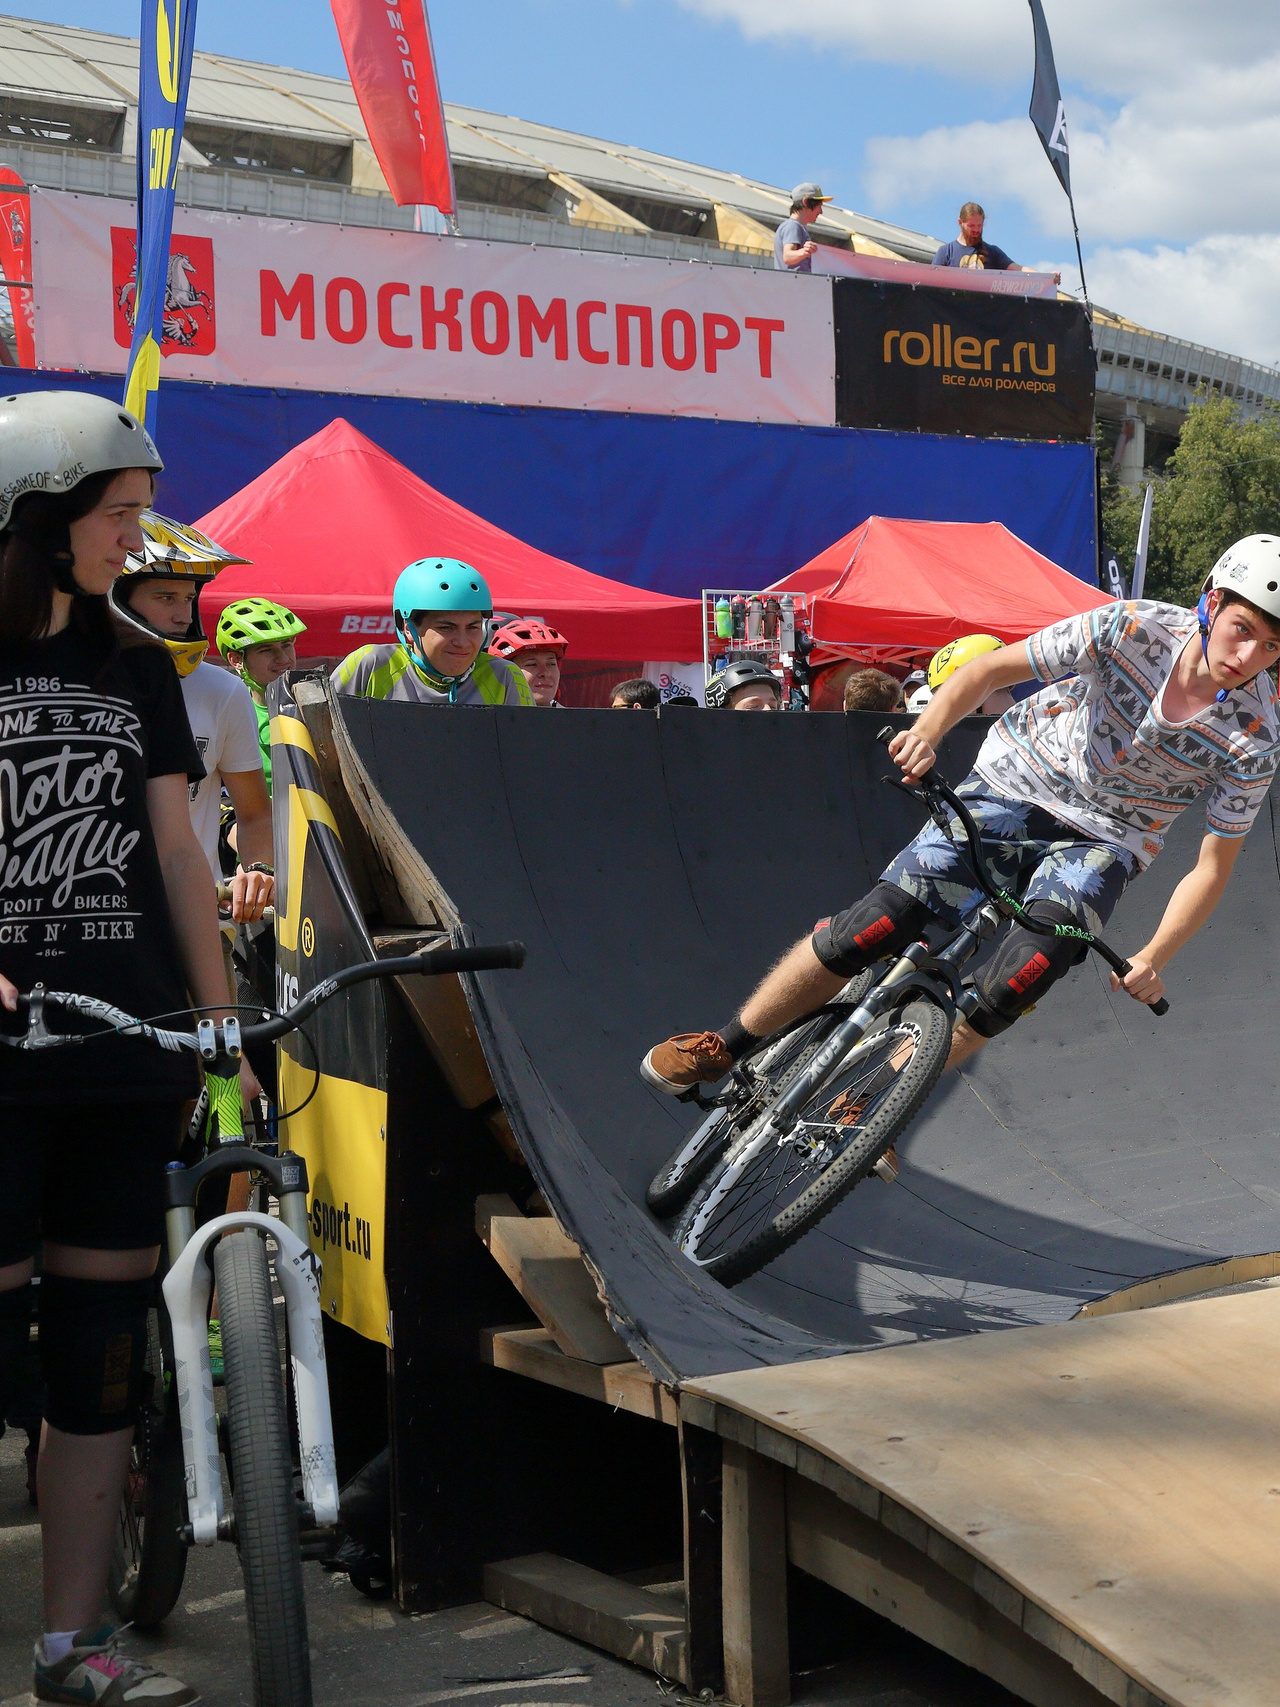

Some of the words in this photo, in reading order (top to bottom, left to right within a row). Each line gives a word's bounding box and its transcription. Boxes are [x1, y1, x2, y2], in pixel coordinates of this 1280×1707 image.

[259, 269, 786, 379] МОСКОМСПОРТ
[884, 324, 1056, 376] roller.ru
[942, 374, 966, 386] все
[968, 377, 993, 389] для
[995, 378, 1056, 394] роллеров
[62, 462, 88, 487] BIKE
[15, 677, 61, 693] 1986
[53, 713, 73, 727] TO
[80, 708, 126, 734] THE
[74, 895, 128, 910] BIKERS
[81, 920, 135, 941] BIKE
